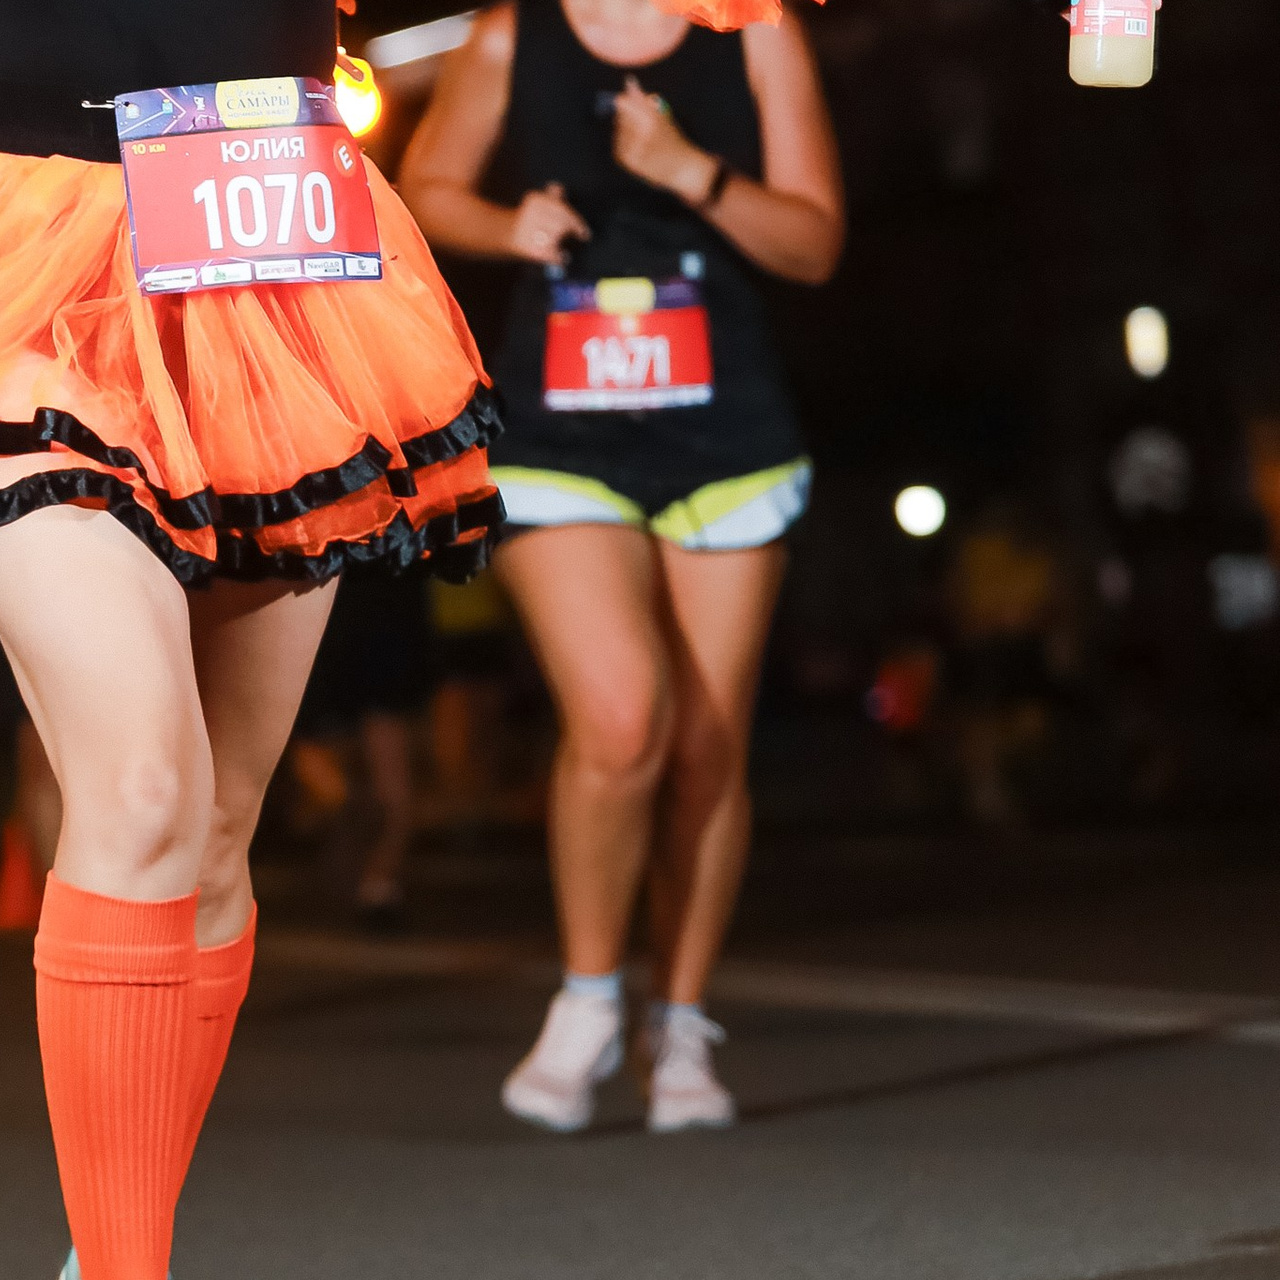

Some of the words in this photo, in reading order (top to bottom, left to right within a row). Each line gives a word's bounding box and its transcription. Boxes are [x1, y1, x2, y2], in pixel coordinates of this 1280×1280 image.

[226, 96, 290, 110] САМАРЫ
[132, 143, 146, 155] 10
[221, 136, 305, 163] ЮЛИЯ
[193, 171, 336, 250] 1070
